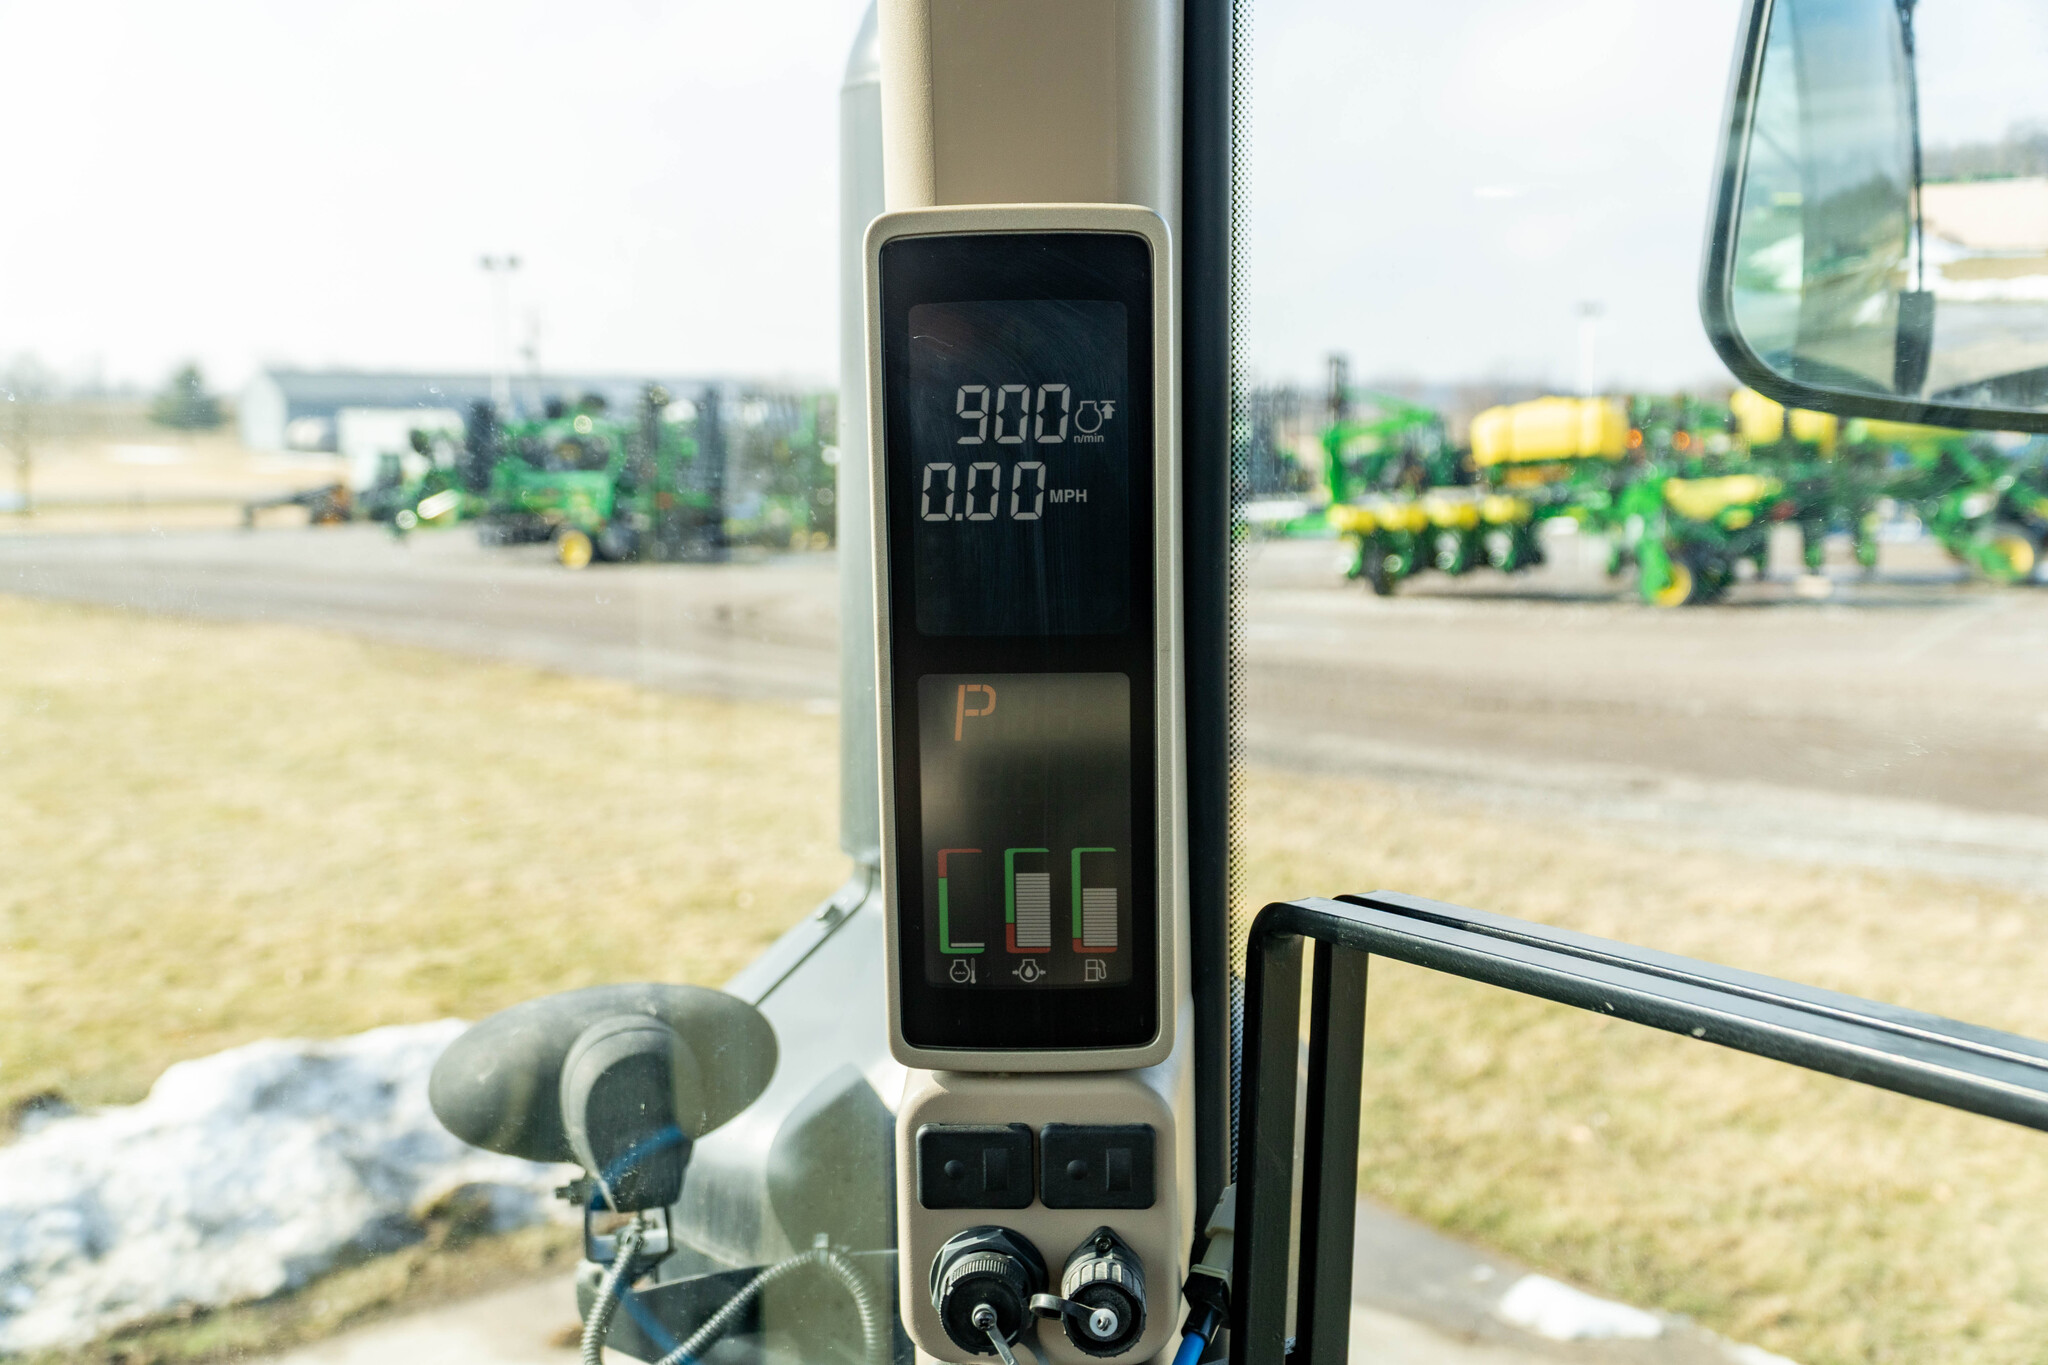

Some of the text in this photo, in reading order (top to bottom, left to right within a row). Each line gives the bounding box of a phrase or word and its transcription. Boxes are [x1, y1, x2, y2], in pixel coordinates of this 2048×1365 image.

[956, 383, 1105, 445] 900 n/min
[920, 461, 1088, 522] 0.00 MPH
[954, 684, 997, 741] P
